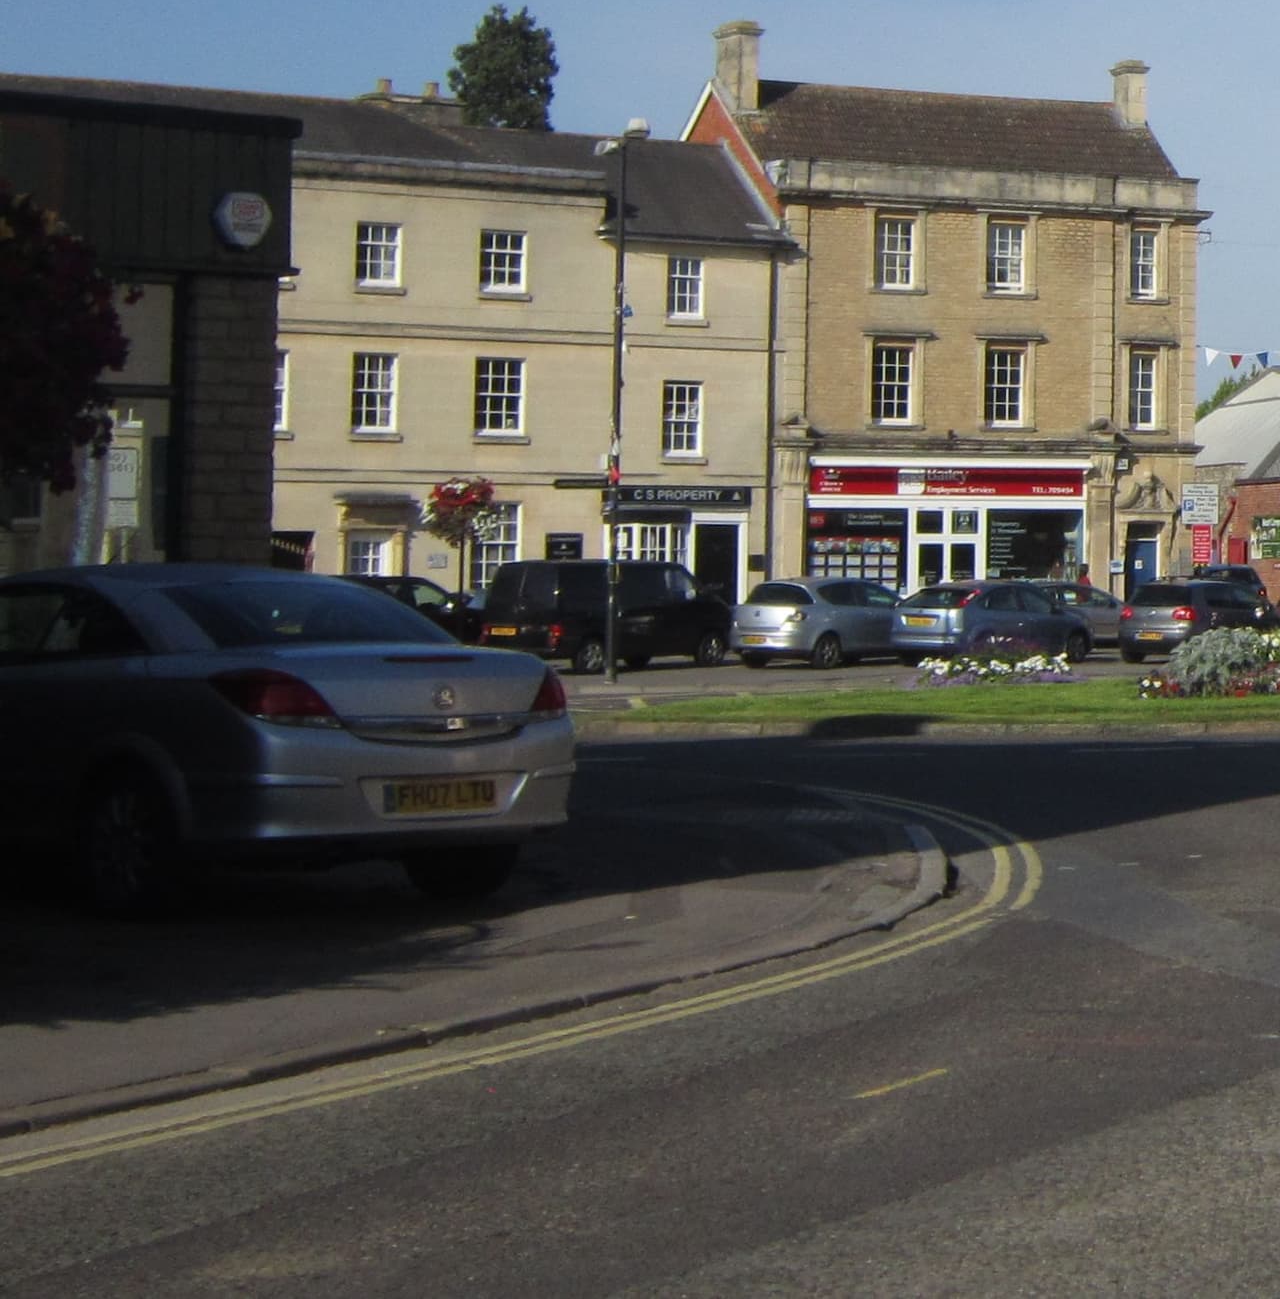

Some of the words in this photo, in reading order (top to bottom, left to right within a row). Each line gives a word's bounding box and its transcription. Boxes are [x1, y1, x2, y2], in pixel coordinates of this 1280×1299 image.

[633, 489, 643, 500] C
[645, 489, 655, 500] S
[657, 490, 722, 500] PROPERTY
[968, 485, 997, 494] Services
